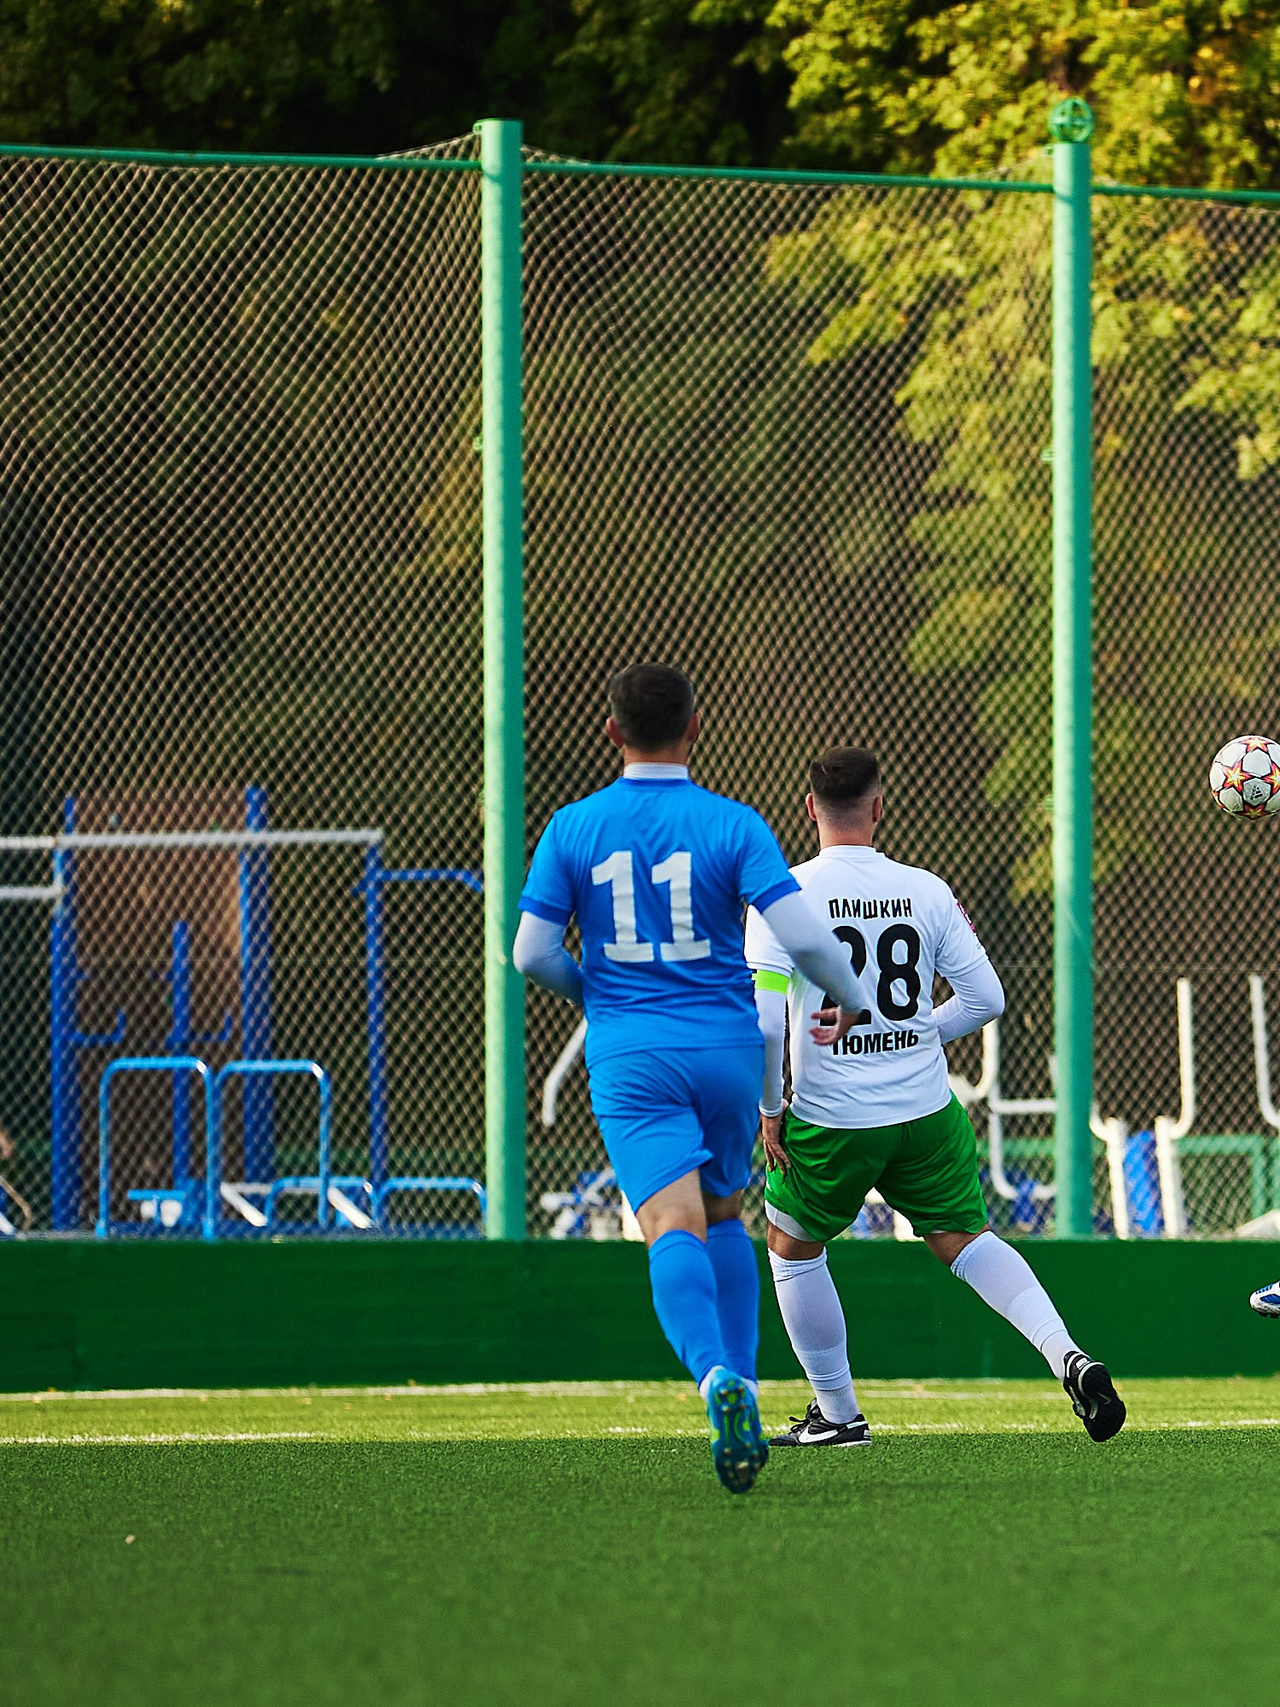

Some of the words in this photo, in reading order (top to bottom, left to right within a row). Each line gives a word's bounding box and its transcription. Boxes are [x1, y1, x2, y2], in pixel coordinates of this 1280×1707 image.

[592, 850, 711, 963] 11
[828, 898, 913, 920] ПЛИШКИН
[833, 1028, 919, 1056] ТЮМЕНЬ
